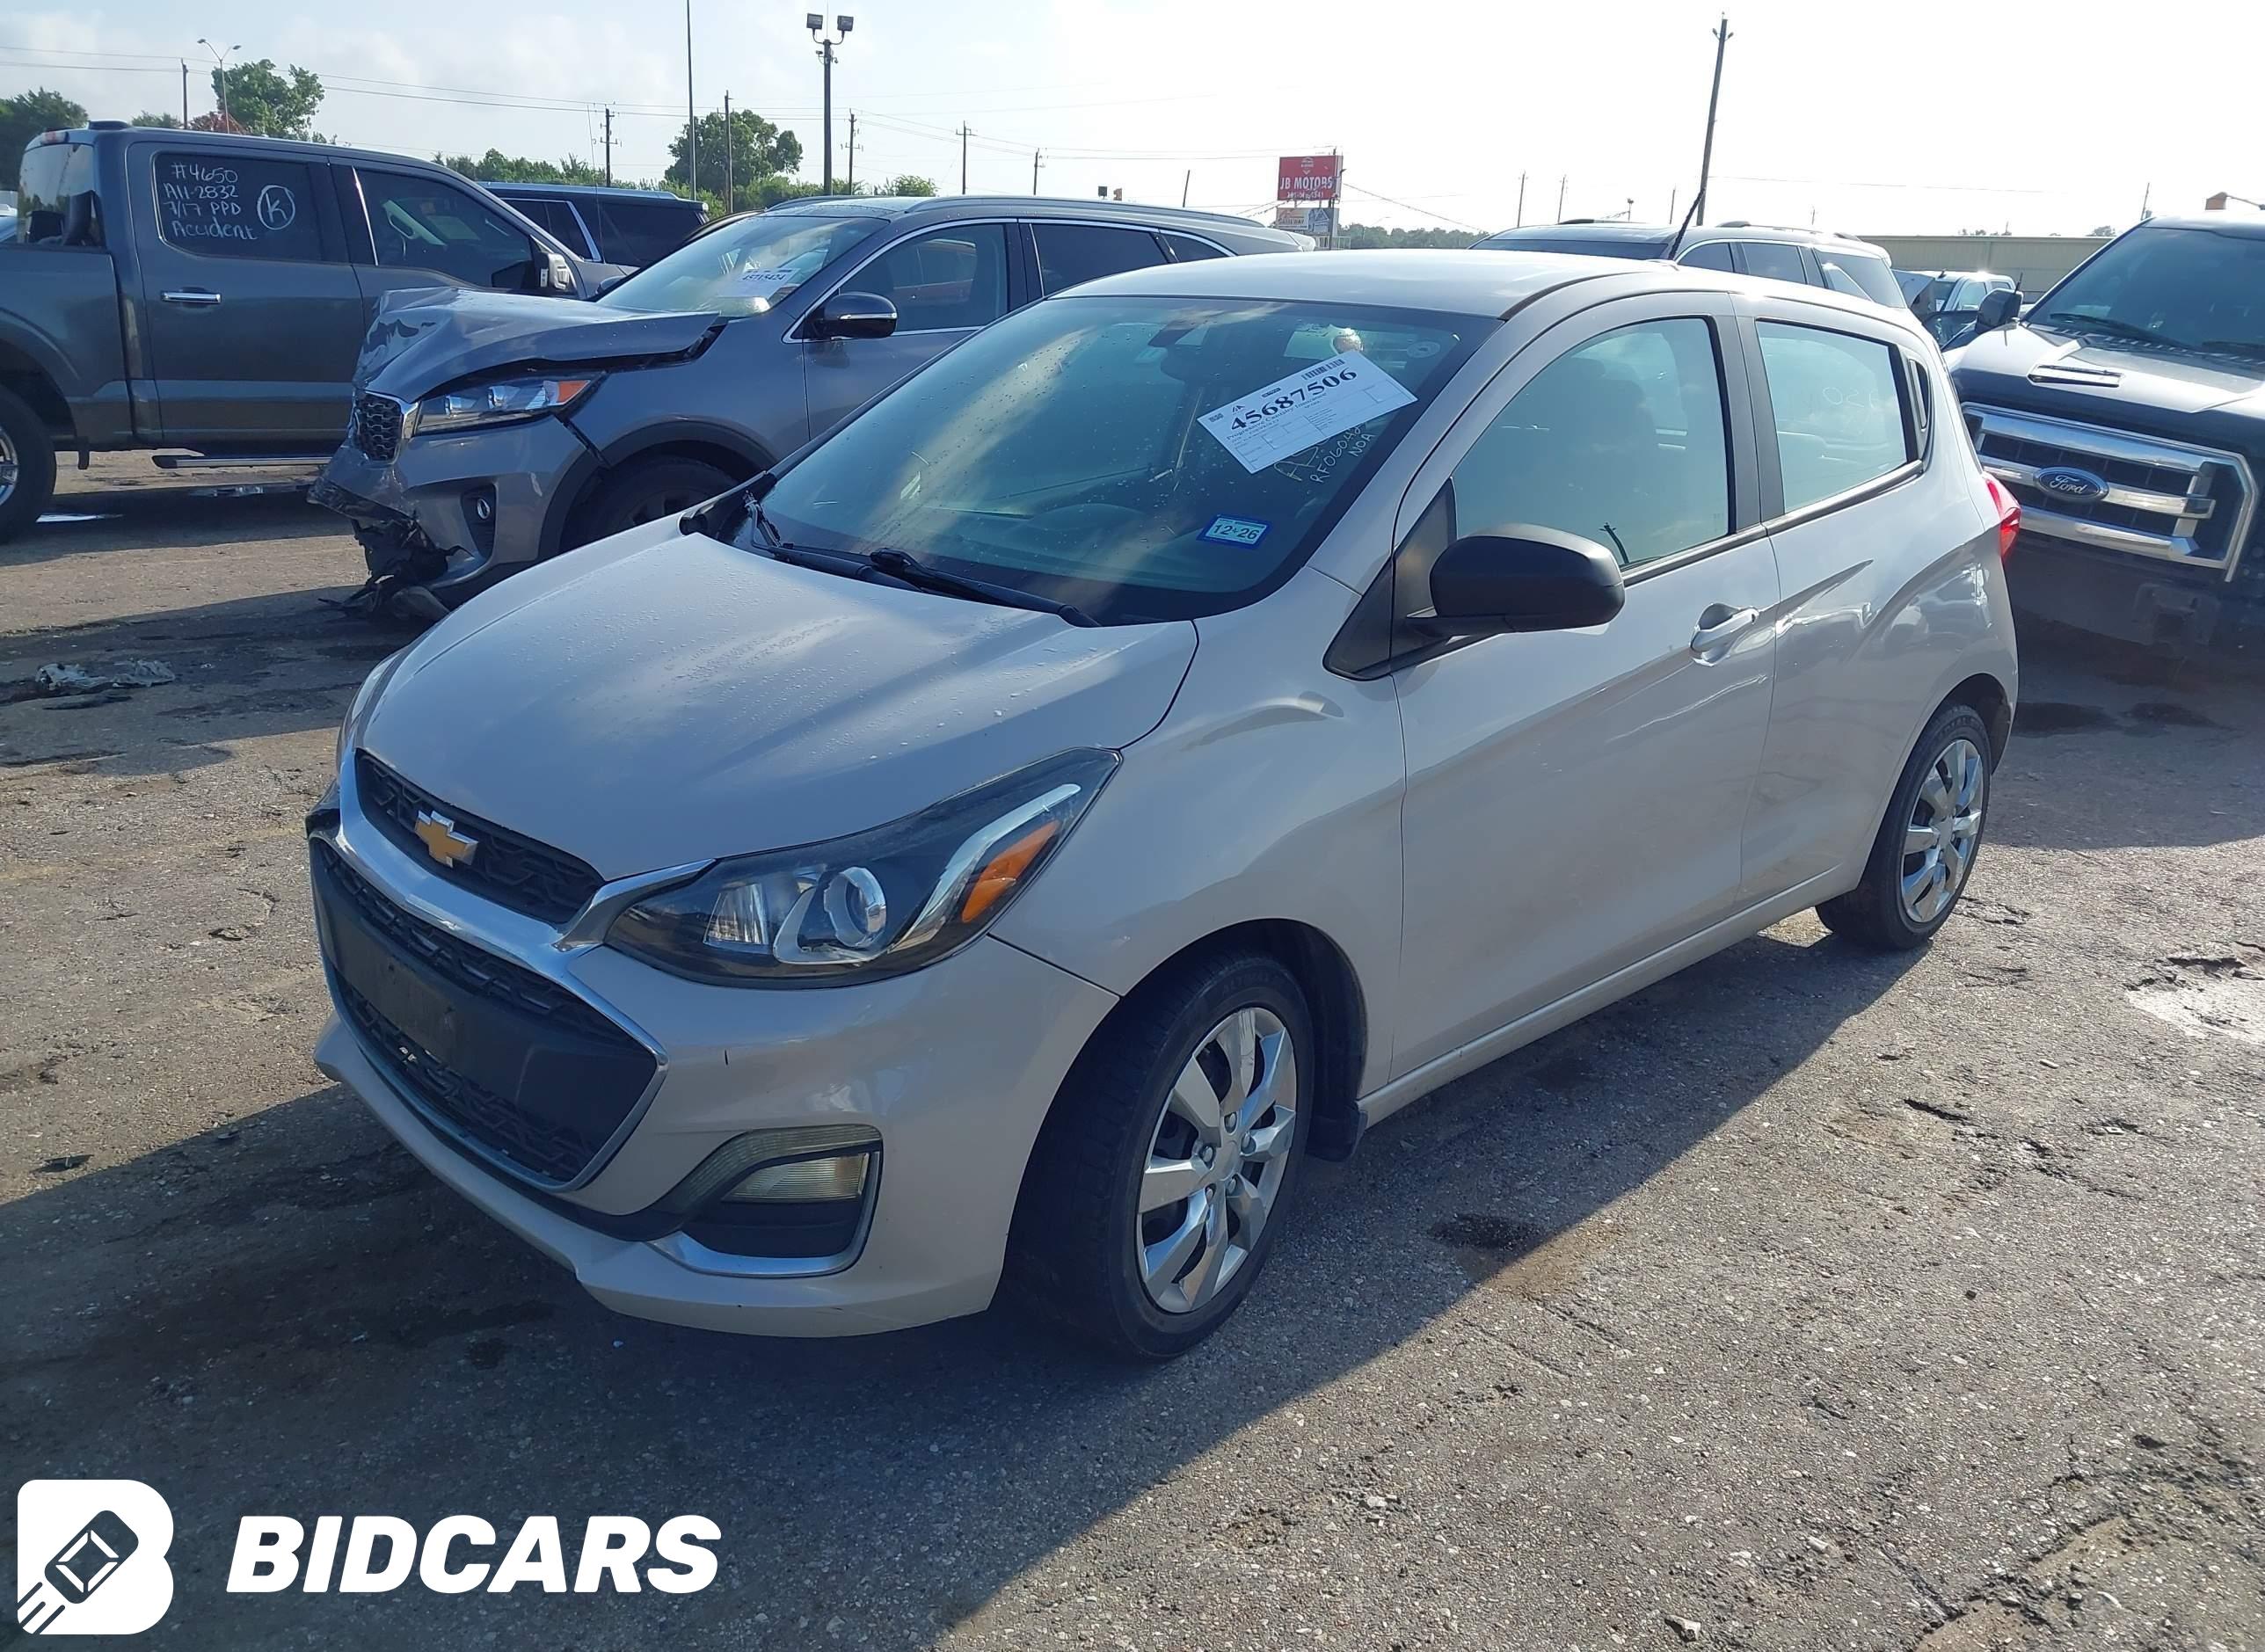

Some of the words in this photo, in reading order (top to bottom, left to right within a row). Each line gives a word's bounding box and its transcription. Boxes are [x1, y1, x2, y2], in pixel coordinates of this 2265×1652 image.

[171, 162, 238, 183] #4650
[1280, 178, 1291, 190] JB
[1293, 176, 1333, 190] MOTORS
[210, 202, 242, 216] PPD
[171, 217, 259, 240] Accident
[1231, 367, 1358, 431] 45687506
[2050, 475, 2088, 494] Ford
